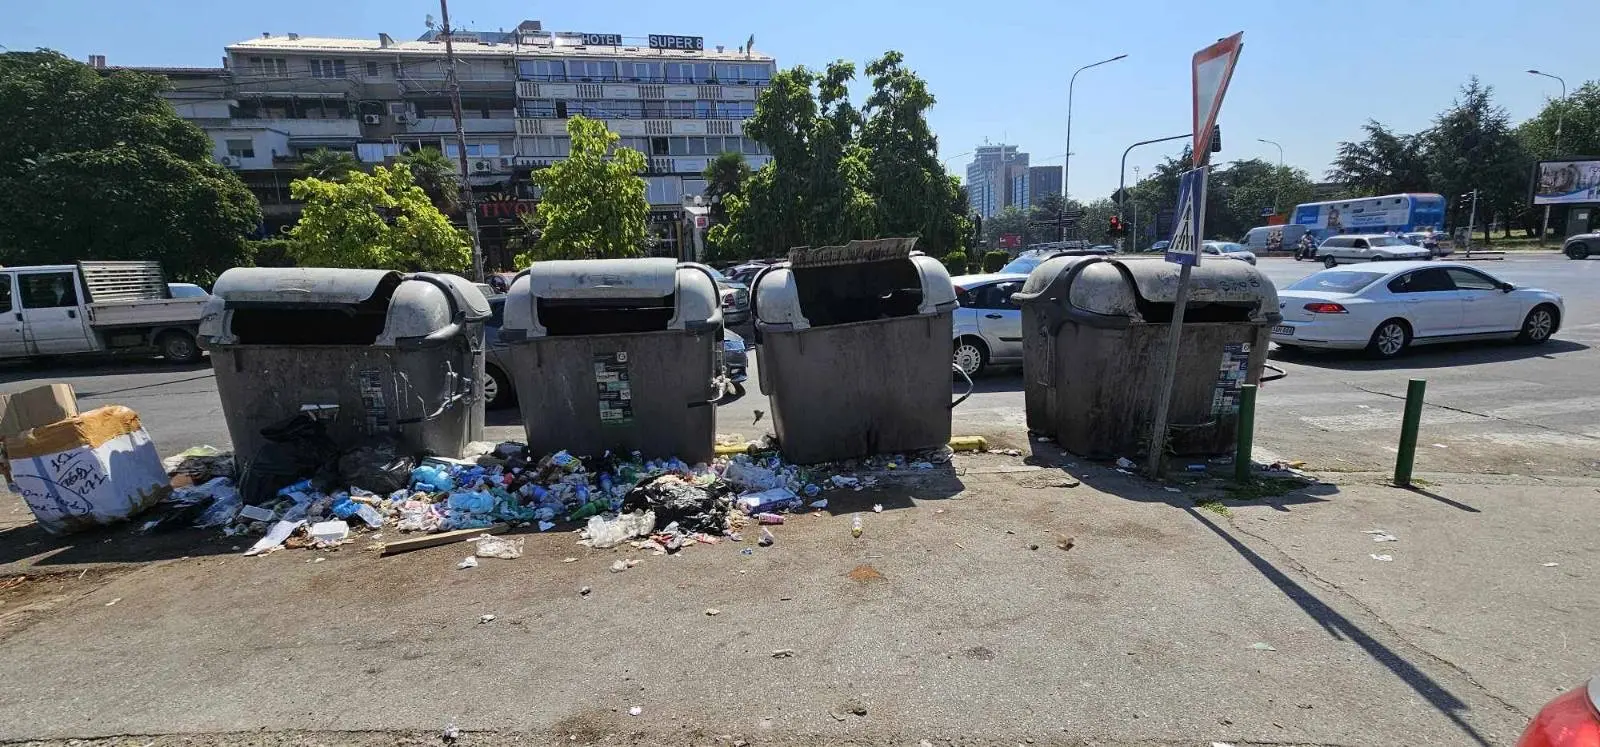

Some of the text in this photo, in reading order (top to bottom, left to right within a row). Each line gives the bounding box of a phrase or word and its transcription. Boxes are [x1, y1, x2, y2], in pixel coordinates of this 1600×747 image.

[582, 33, 703, 49] HOTEL SUPER 8
